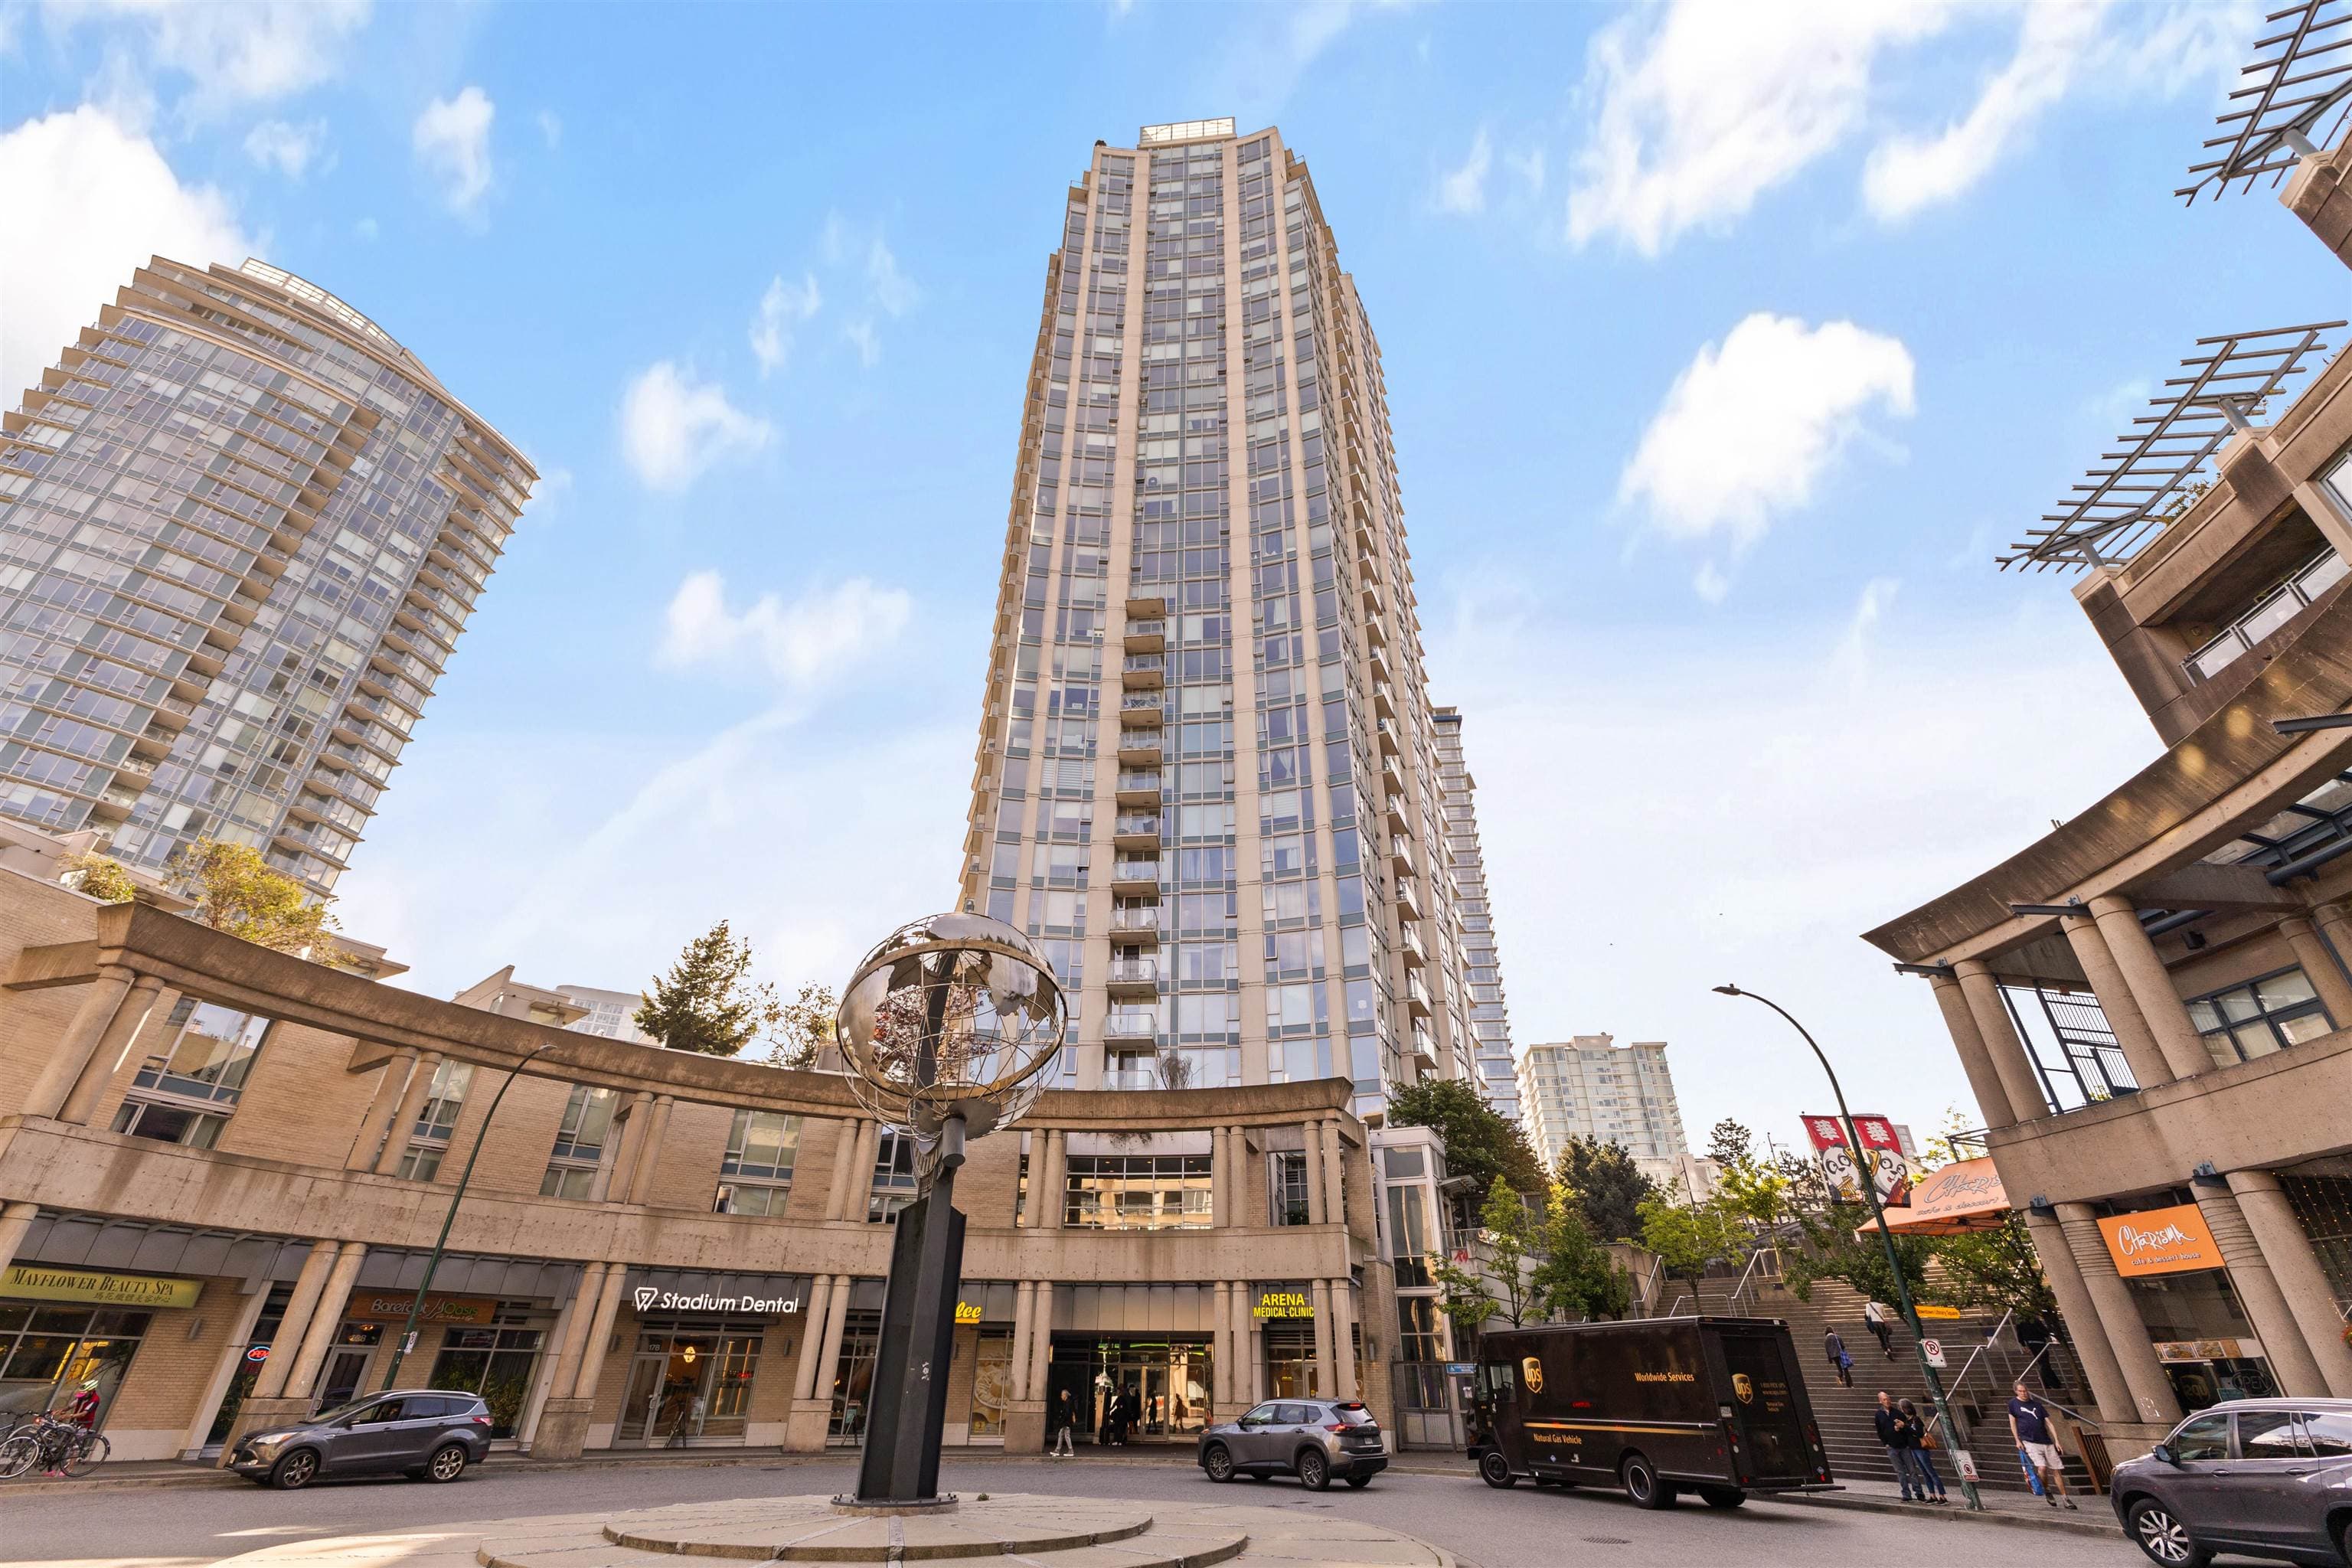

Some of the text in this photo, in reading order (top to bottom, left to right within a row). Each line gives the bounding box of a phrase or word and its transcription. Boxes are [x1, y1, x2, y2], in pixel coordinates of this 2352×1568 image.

[1812, 1119, 1840, 1141] 華
[1864, 1121, 1891, 1142] 華
[2154, 1254, 2180, 1263] dessert
[2180, 1252, 2201, 1260] house
[9, 1268, 175, 1295] MAYFLOWER BEAUTY SPA
[661, 1292, 799, 1313] Stadium Dental
[1262, 1293, 1305, 1305] ARENA
[445, 1303, 479, 1315] Oasis
[1253, 1306, 1315, 1317] MEDICAL CLINIC
[1526, 1367, 1541, 1387] ups
[1635, 1372, 1695, 1382] Worldwide Services
[1735, 1383, 1752, 1399] ups
[1534, 1433, 1582, 1444] Natural Gas Vehicle
